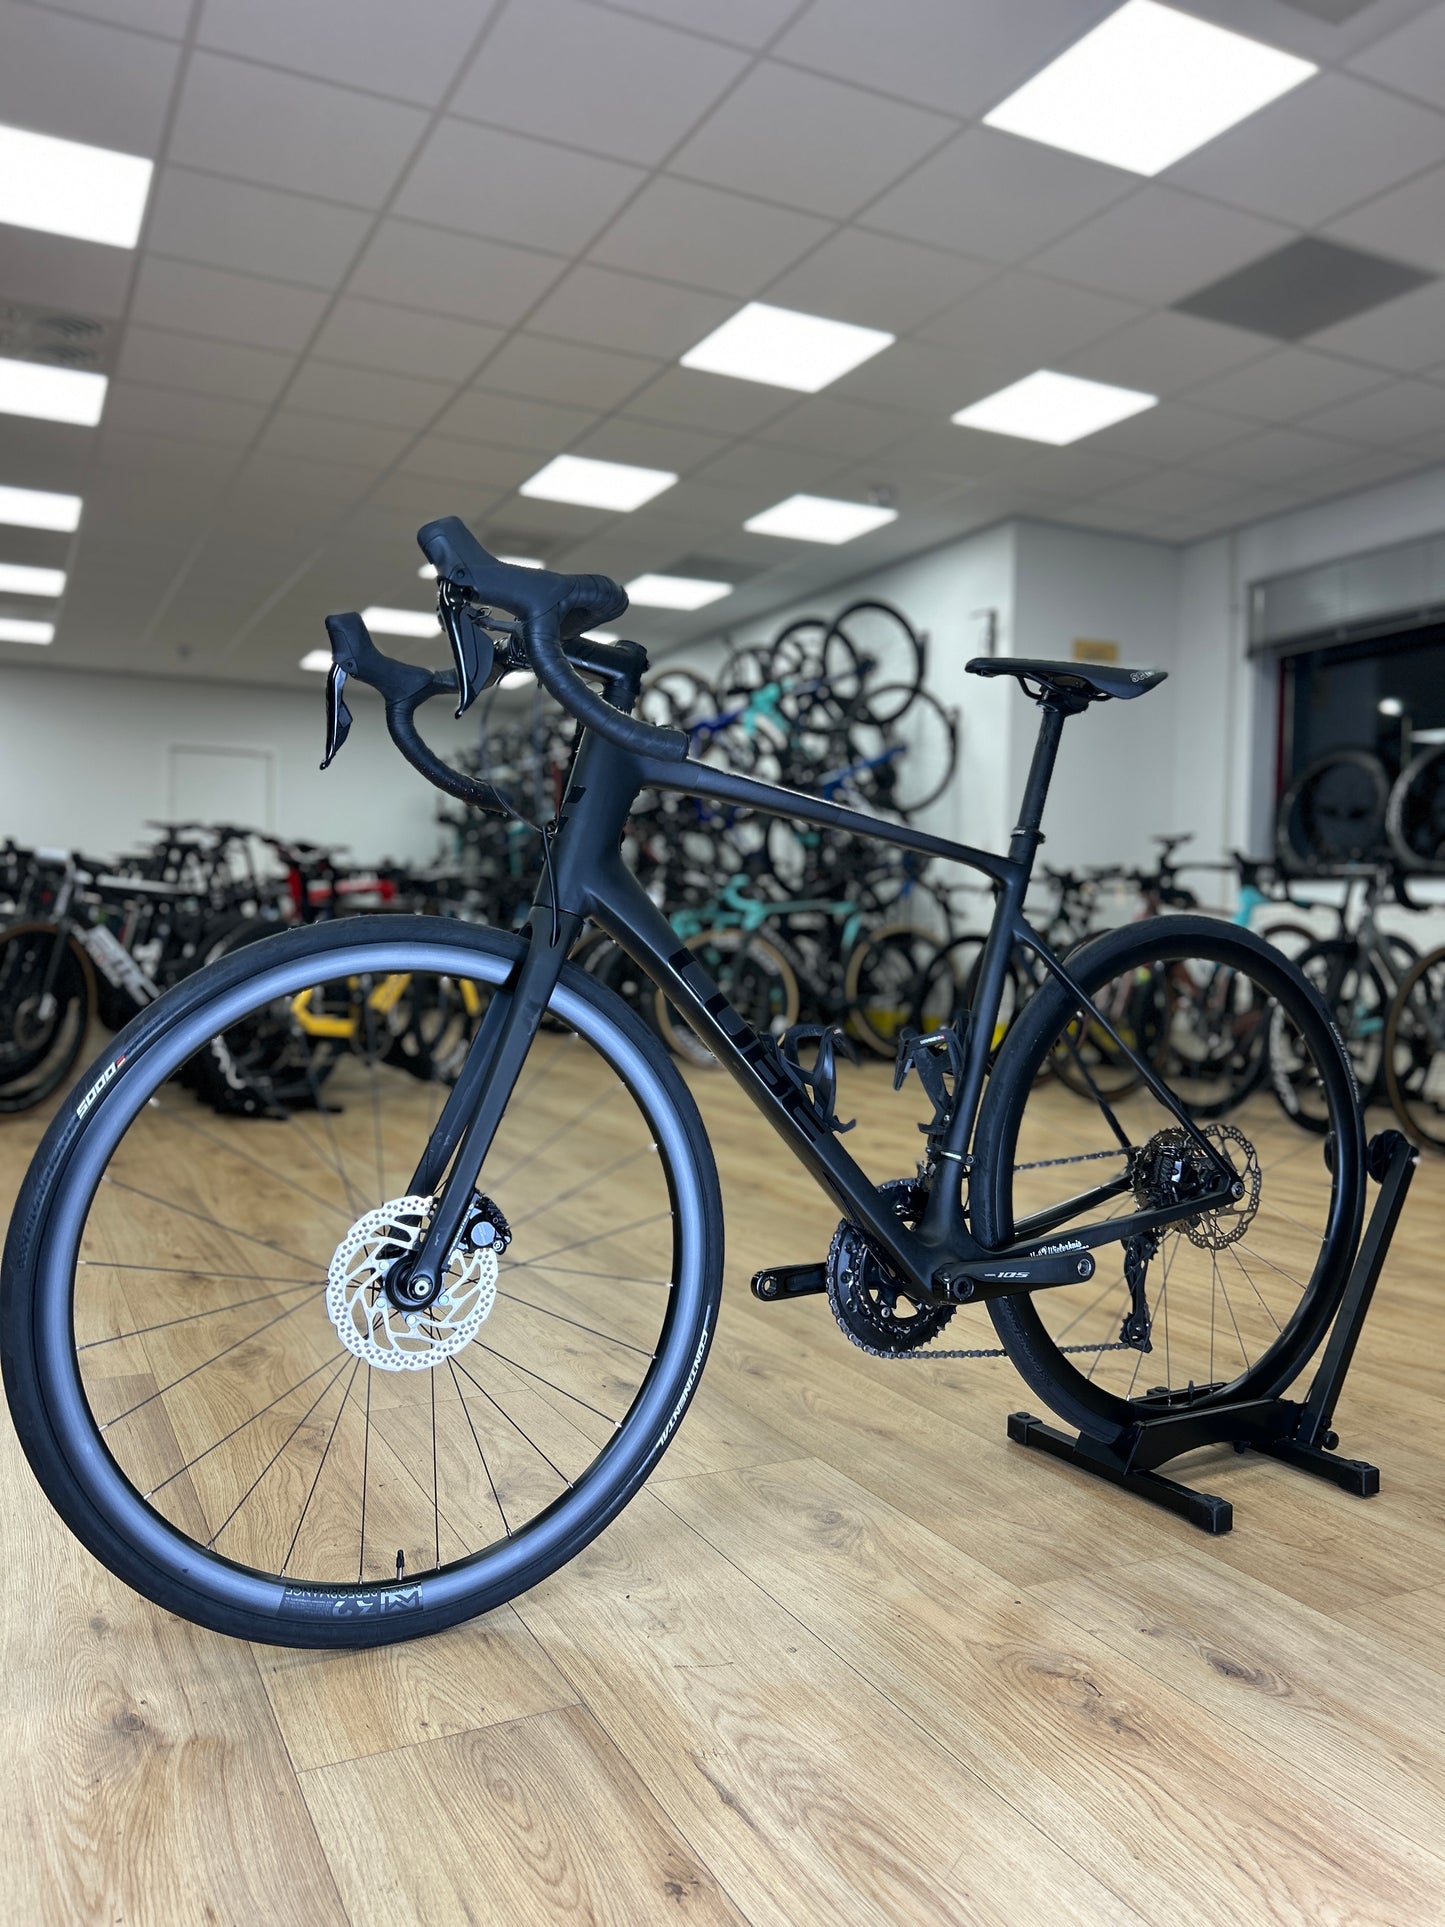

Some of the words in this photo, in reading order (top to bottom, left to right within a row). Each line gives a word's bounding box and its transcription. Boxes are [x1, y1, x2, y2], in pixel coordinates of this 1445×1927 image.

[76, 1061, 117, 1120] 5000
[655, 1328, 709, 1449] CONTINENTAL
[285, 1586, 378, 1599] PERFORMANCE
